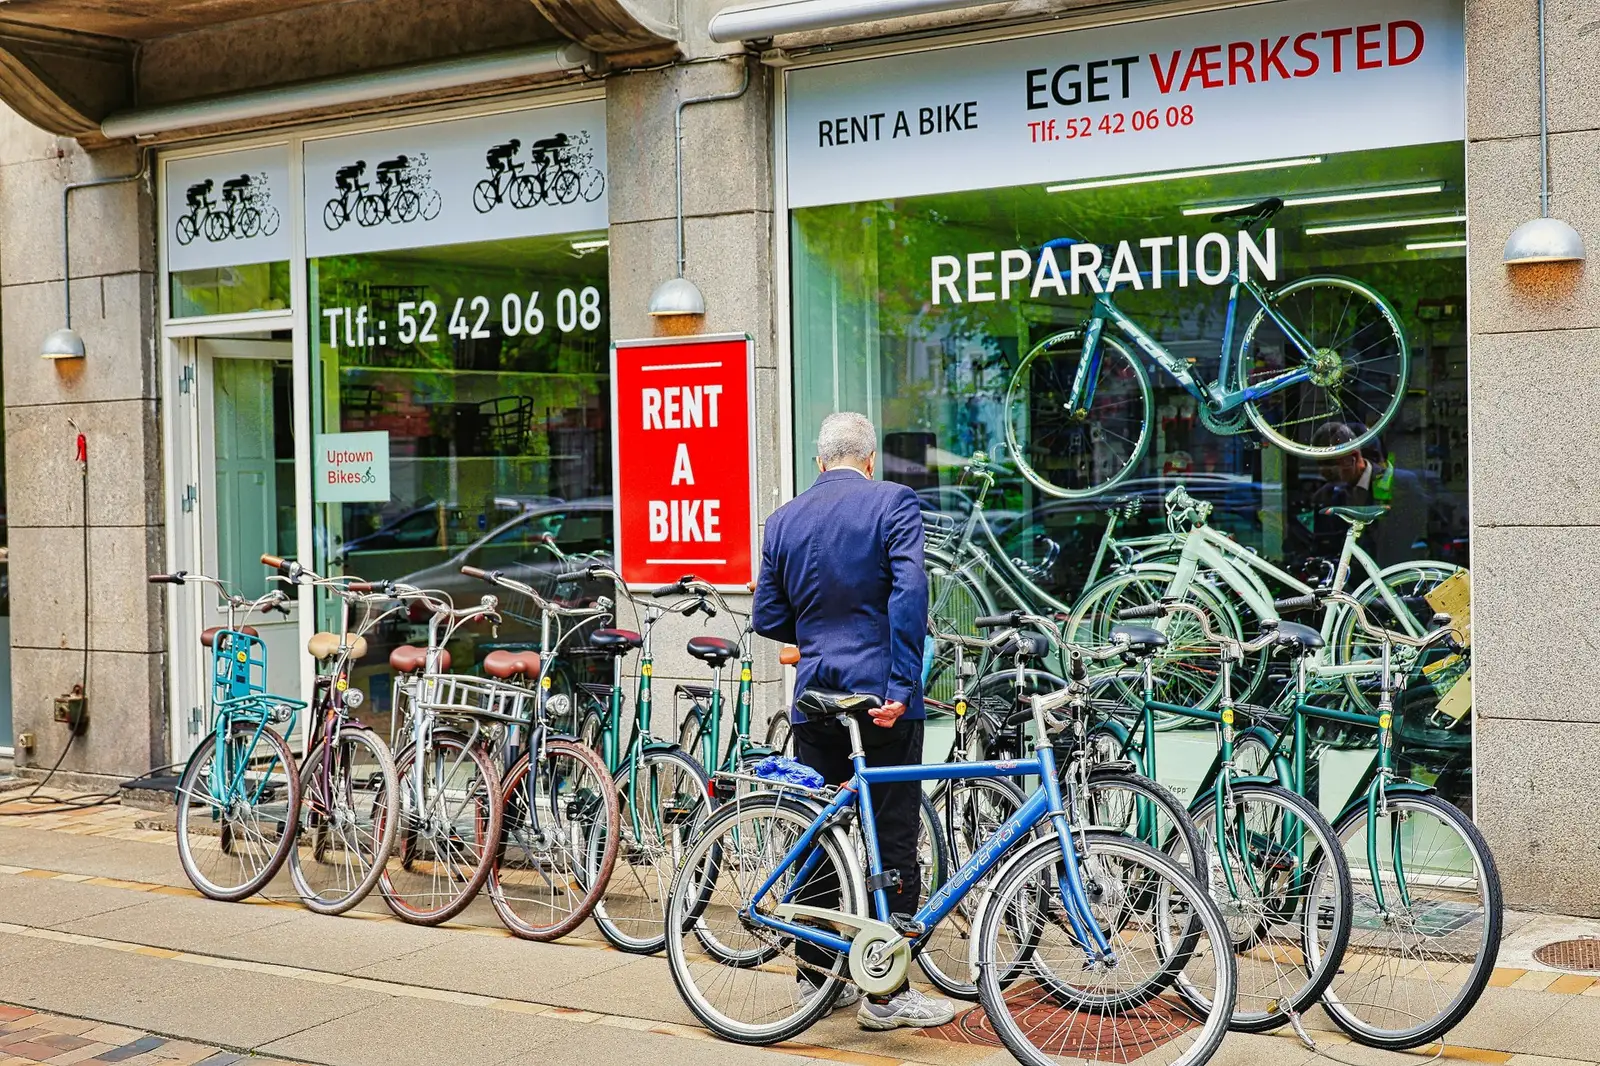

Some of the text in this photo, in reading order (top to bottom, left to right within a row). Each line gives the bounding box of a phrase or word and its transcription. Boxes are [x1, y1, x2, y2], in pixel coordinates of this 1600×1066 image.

[1025, 19, 1425, 111] EGET VÆRKSTED
[818, 101, 978, 147] RENT A BIKE
[1027, 104, 1194, 143] Tlf. 52 42 06 08
[931, 228, 1276, 305] REPARATION
[322, 286, 601, 348] Tlf.: 52 42 06 08
[641, 384, 723, 430] RENT
[327, 449, 373, 466] Uptown
[328, 469, 361, 484] Bikes
[671, 443, 695, 486] A
[649, 499, 721, 543] BIKE
[1168, 784, 1187, 794] Yepp
